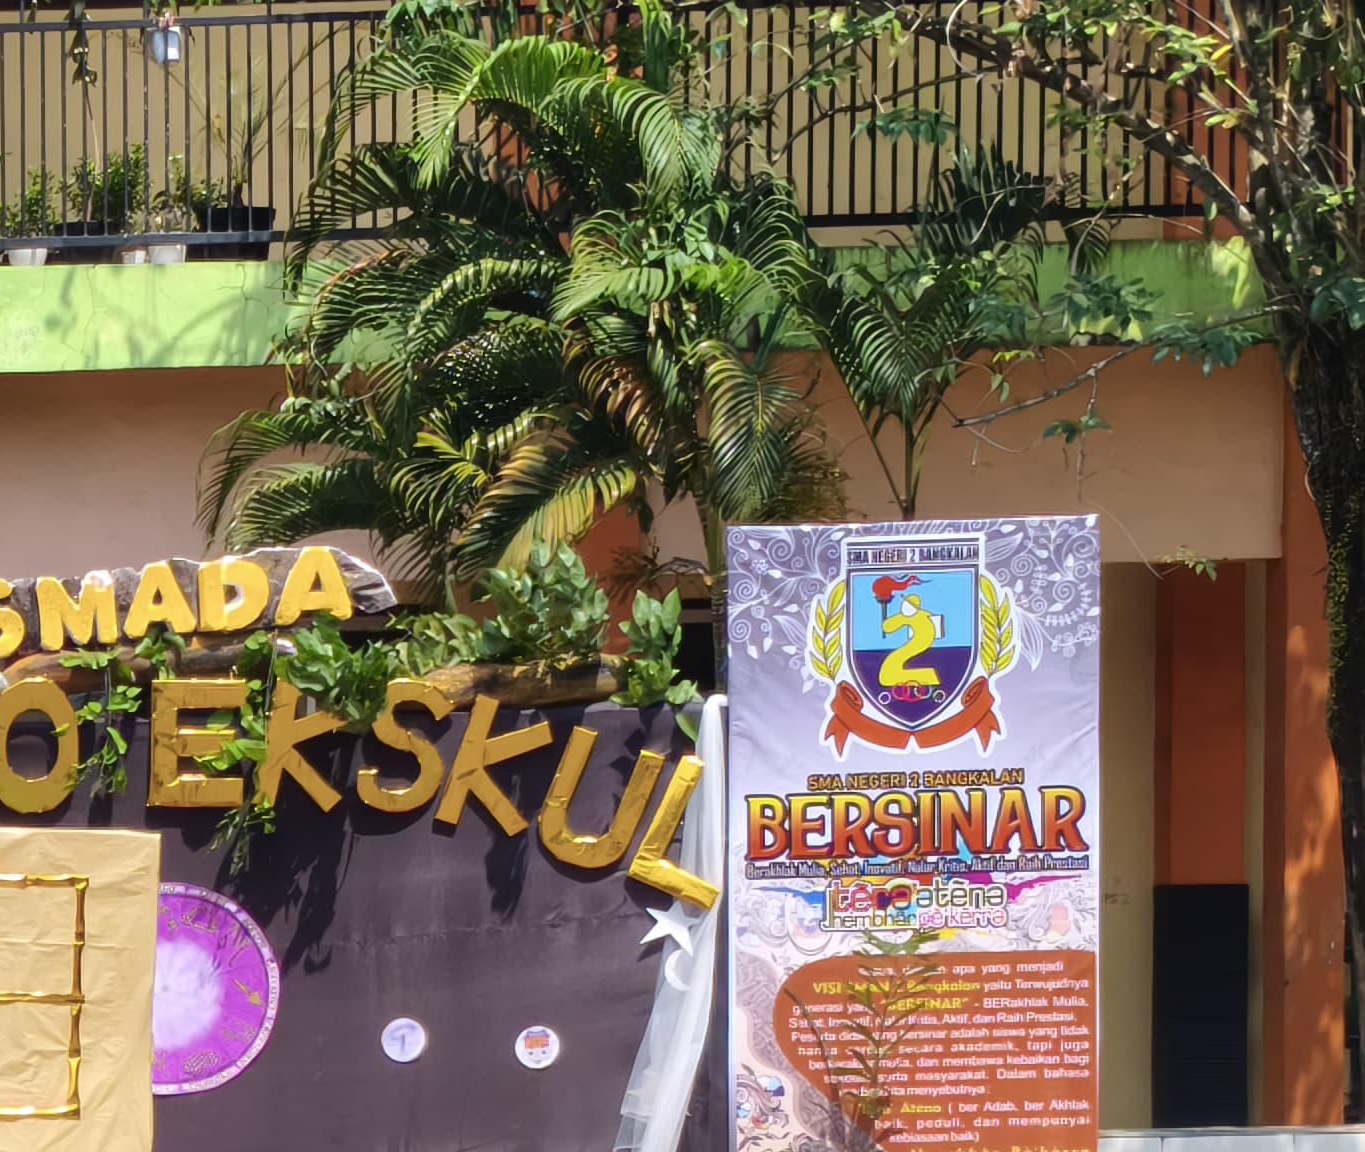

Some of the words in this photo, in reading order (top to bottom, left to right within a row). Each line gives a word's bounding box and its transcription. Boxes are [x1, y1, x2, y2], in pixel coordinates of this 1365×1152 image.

[808, 774, 845, 791] SMA
[847, 772, 906, 789] NEGERI
[908, 772, 919, 788] 2
[924, 768, 1025, 787] BANGKALAN
[149, 676, 724, 911] EKSKUL
[744, 787, 1090, 861] BERSINAR
[952, 965, 976, 975] apa
[981, 964, 1010, 975] yang
[1016, 961, 1064, 974] menjadi
[813, 982, 842, 994] VISI
[984, 981, 1012, 992] yaitu
[1015, 978, 1089, 991] Terwujudnya
[793, 1004, 843, 1016] gnerasi
[983, 997, 1048, 1009] BERakhlak
[973, 1013, 995, 1024] dan
[997, 1012, 1023, 1023] Raih
[950, 1027, 989, 1039] adalah
[1028, 1027, 1058, 1039] yang
[1060, 1025, 1089, 1036] tidak
[1027, 1041, 1052, 1052] tapi
[1060, 1040, 1089, 1052] juga
[916, 1057, 939, 1067] dan
[943, 1056, 1003, 1067] membawa
[1006, 1054, 1060, 1065] kebaikan
[997, 1068, 1036, 1080] Dalam
[1044, 1067, 1089, 1079] bahasa
[959, 1102, 978, 1112] ber
[1024, 1101, 1045, 1111] ber
[1049, 1099, 1090, 1111] Akhlak
[973, 1116, 1000, 1127] dan
[1008, 1115, 1090, 1128] mempunyai
